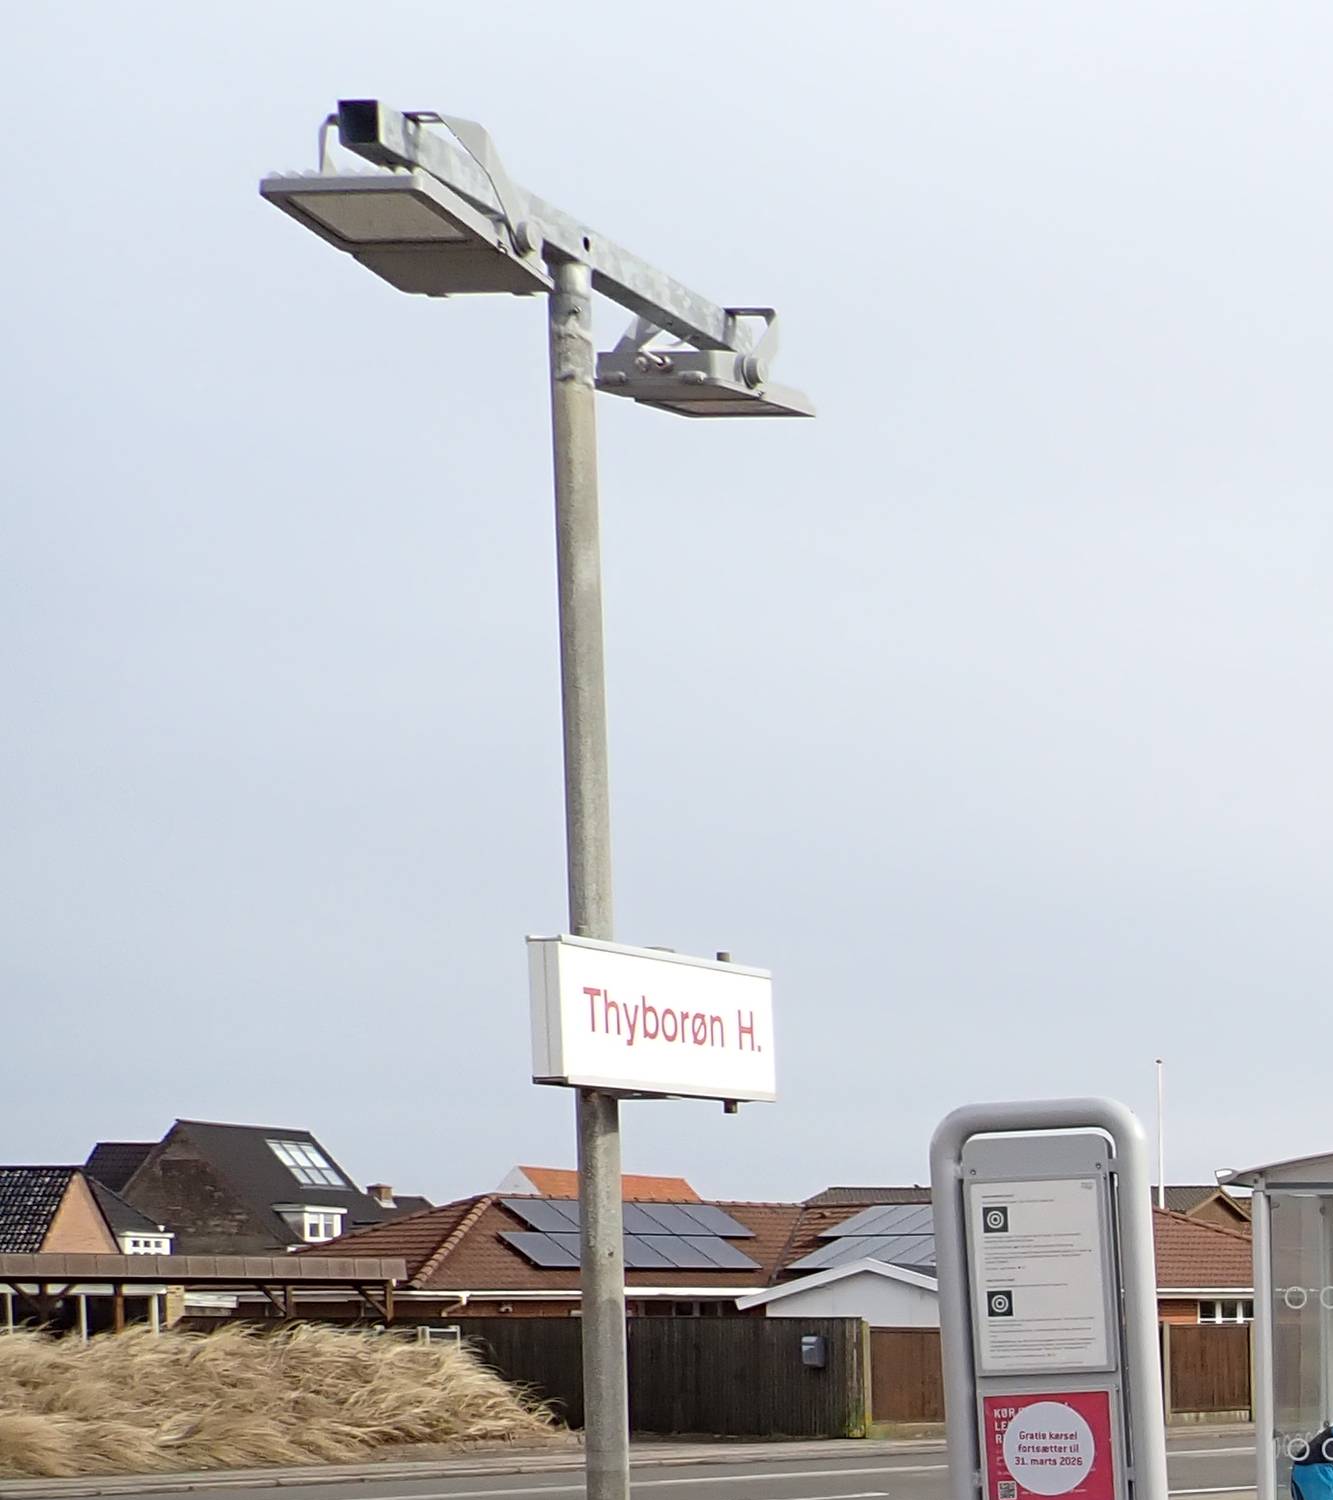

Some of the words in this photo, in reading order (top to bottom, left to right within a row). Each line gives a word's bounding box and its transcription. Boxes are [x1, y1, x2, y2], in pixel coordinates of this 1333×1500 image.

[583, 986, 724, 1047] Thyborøn
[737, 1009, 761, 1052] H.
[1019, 1431, 1047, 1441] Gratis
[1018, 1444, 1067, 1453] fortsætter
[1069, 1444, 1079, 1453] til
[1015, 1456, 1028, 1466] 31.
[1030, 1457, 1057, 1466] marts
[1060, 1456, 1083, 1466] 2026
